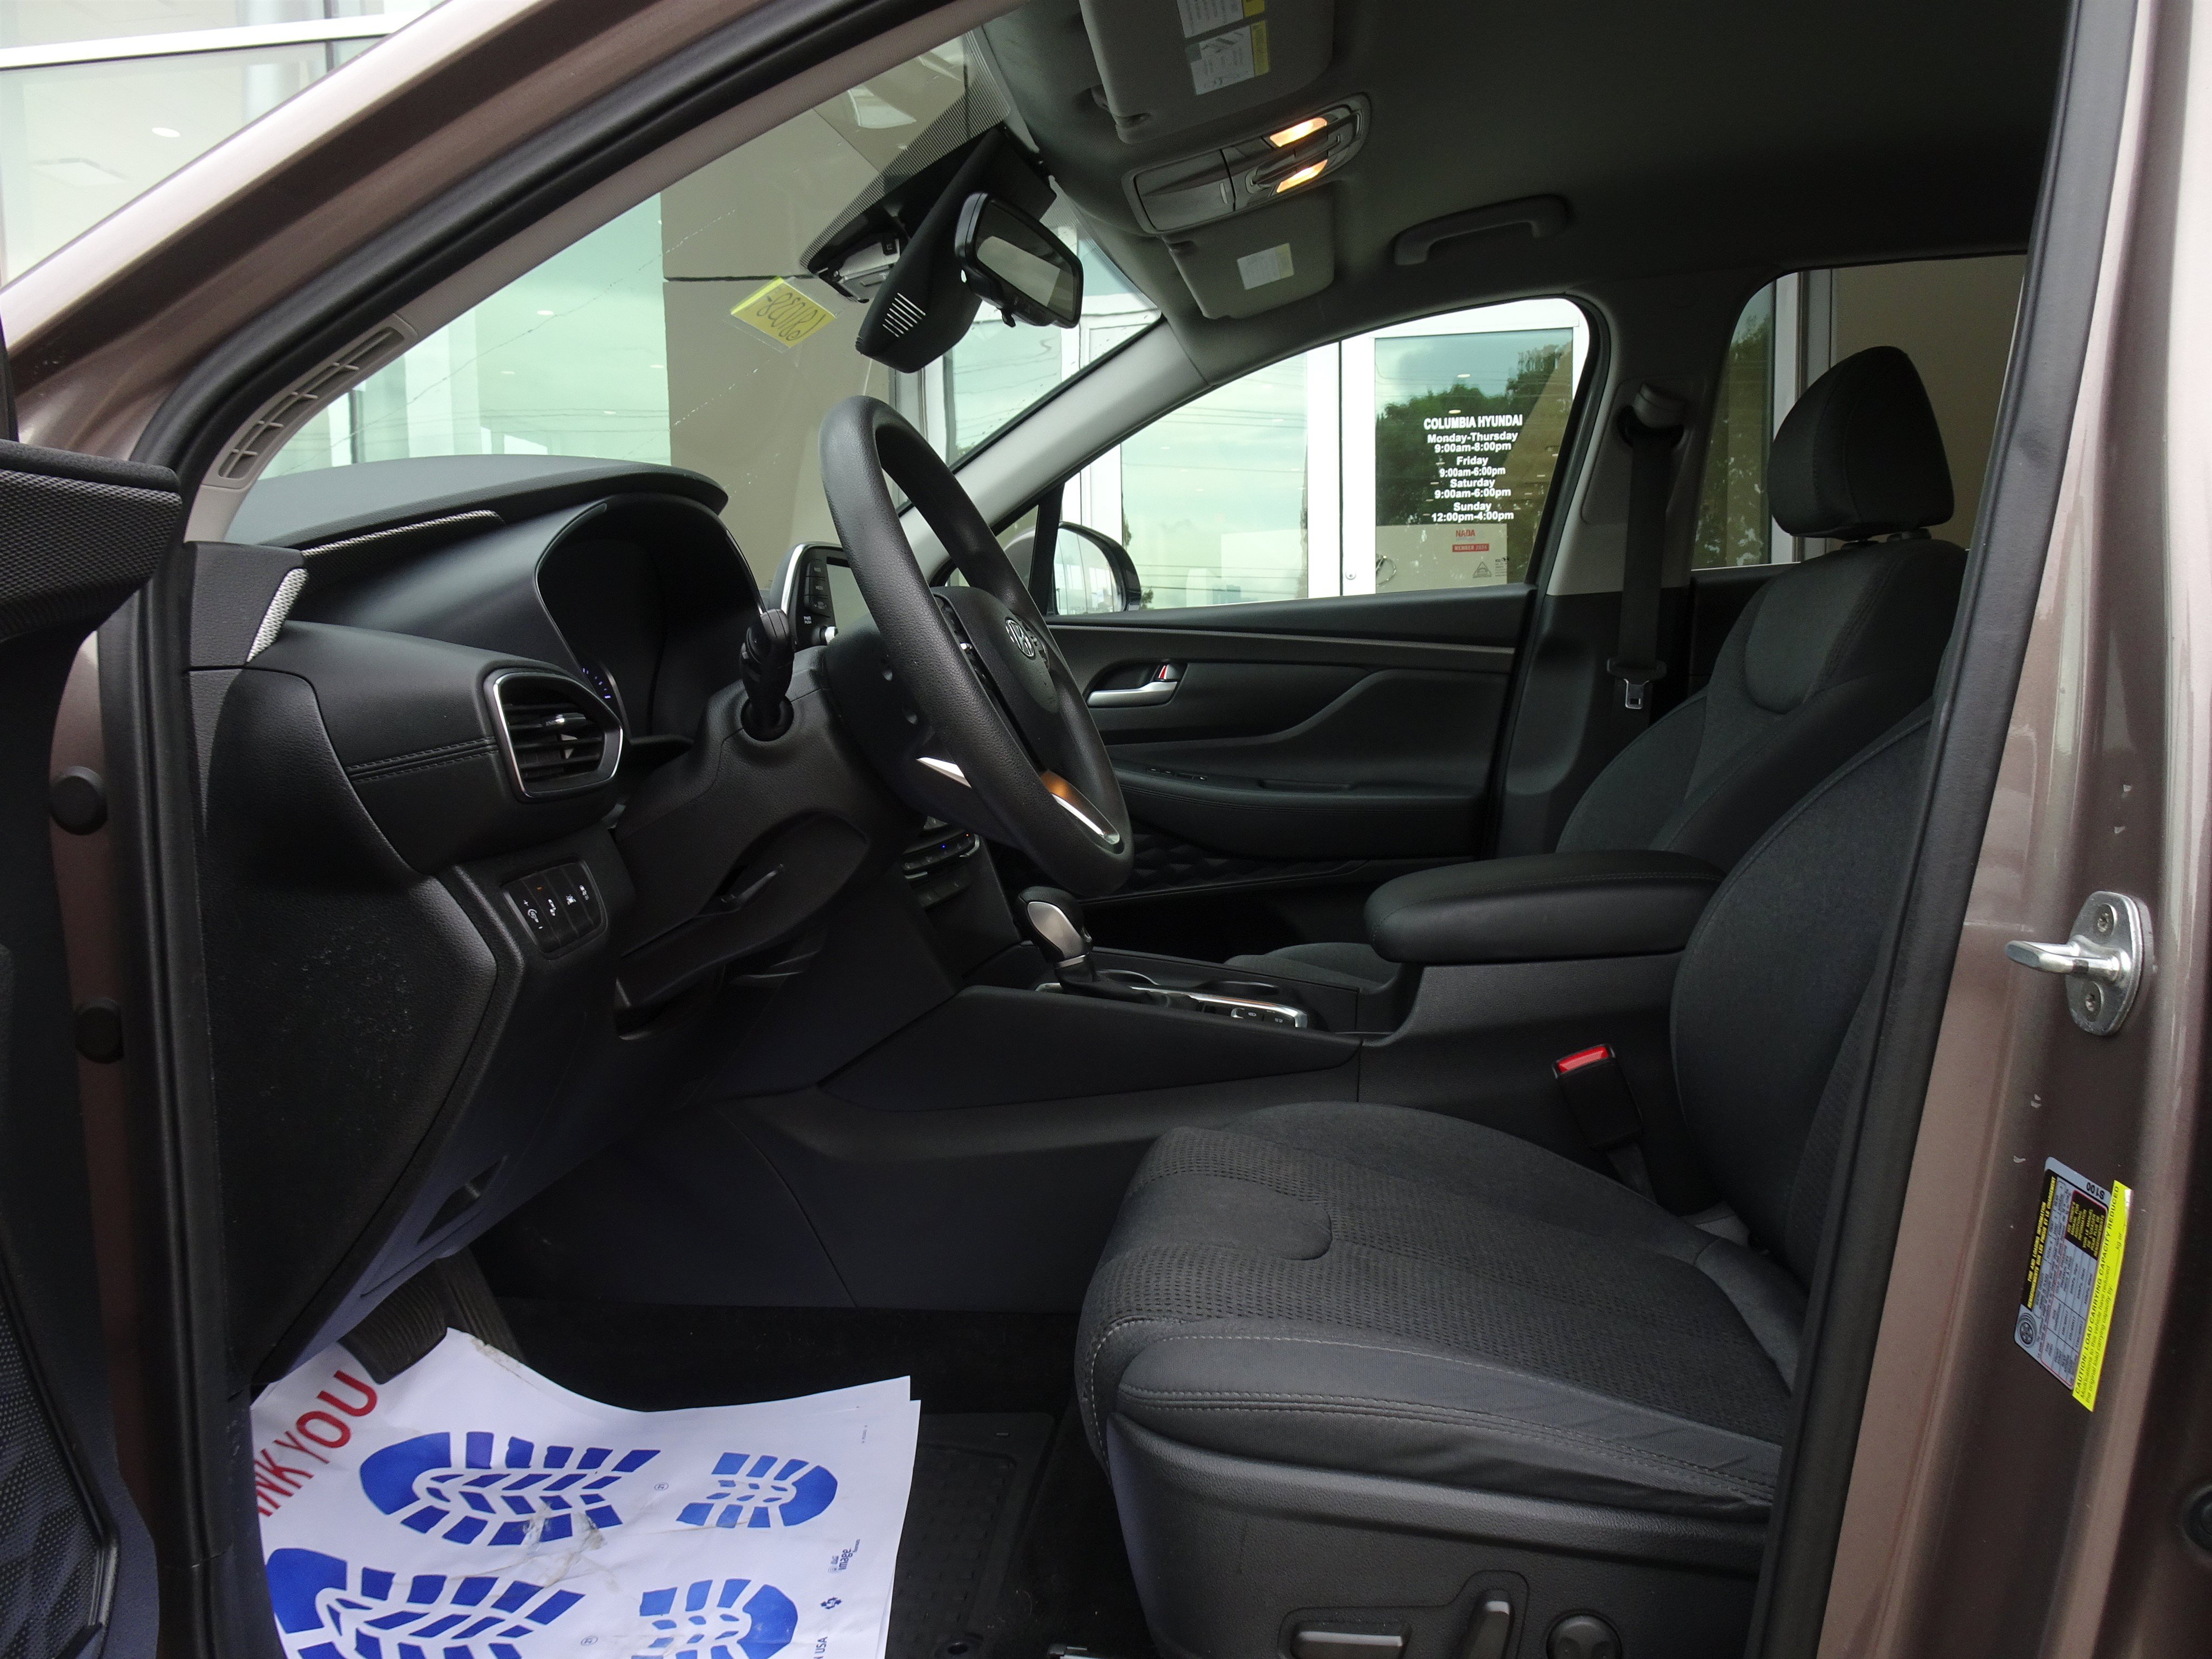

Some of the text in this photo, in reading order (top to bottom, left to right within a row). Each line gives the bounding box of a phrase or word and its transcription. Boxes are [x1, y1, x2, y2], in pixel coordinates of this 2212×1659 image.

[1424, 414, 1523, 430] COLUMBIA HYUNDAI
[1427, 431, 1518, 444] Monday-Thursday
[1434, 442, 1512, 453] 9:00am-8:00pm
[1456, 456, 1489, 466] Friday
[1439, 466, 1506, 477] 9:00am-6:00pm
[1450, 478, 1495, 488] Saturday
[1434, 488, 1511, 498] 9:00am-6:00pm
[1453, 502, 1492, 511] Sunday
[1432, 511, 1514, 523] 12:00pm-4:00pm
[2087, 1182, 2105, 1199] S100
[2117, 1232, 2122, 1240] or
[2115, 1240, 2121, 1250] kg
[2083, 1325, 2093, 1351] LOAD
[2089, 1277, 2102, 1325] CARRYING
[2099, 1231, 2110, 1276] CAPACITY
[2107, 1185, 2119, 1229] REDUCED
[2101, 1295, 2110, 1324] capacity
[2080, 1355, 2092, 1400] Modifications
[2089, 1347, 2094, 1355] to
[2093, 1310, 2101, 1335] vehicle
[2101, 1264, 2110, 1293] reduced
[2096, 1324, 2105, 1352] carrying
[2088, 1366, 2096, 1392] original
[254, 1370, 378, 1517] NK YOU
[814, 1636, 828, 1654] USA
